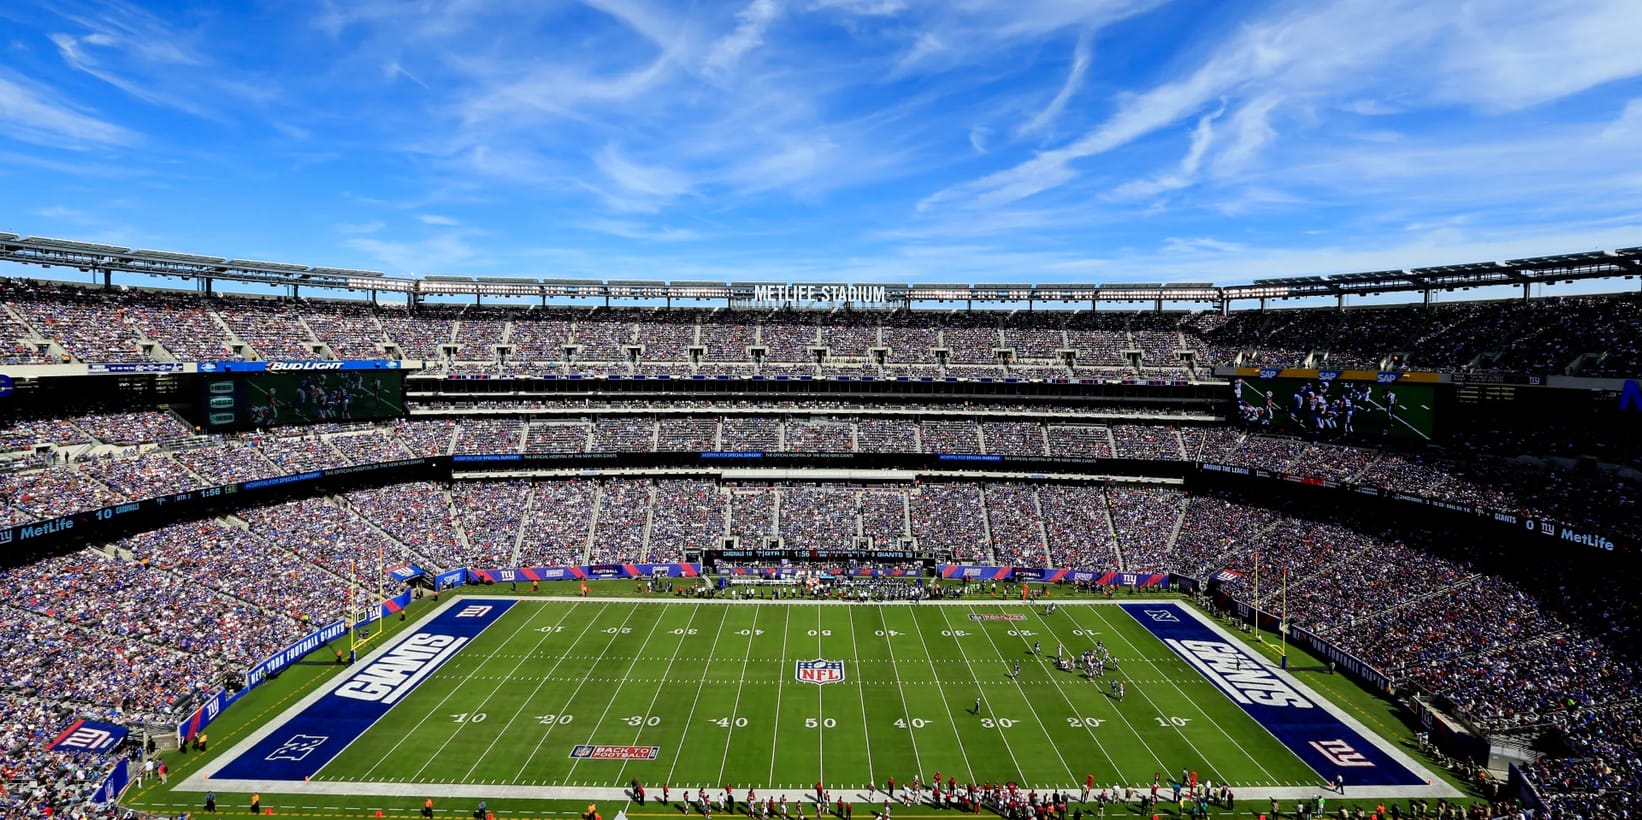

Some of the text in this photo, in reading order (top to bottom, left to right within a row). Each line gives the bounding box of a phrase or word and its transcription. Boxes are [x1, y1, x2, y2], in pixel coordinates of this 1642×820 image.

[754, 285, 885, 302] METLIFE STADIUM
[271, 361, 344, 370] BUD LIGHT
[1378, 375, 1396, 383] SAP
[200, 488, 221, 498] 1:56
[96, 509, 112, 520] 10
[1494, 513, 1534, 530] GIANTS 0
[20, 518, 74, 540] MetLife
[1561, 528, 1614, 551] MetLife
[501, 570, 515, 580] ny
[1123, 574, 1137, 584] ny
[266, 653, 285, 673] YORK
[287, 635, 319, 664] FOOTBALL
[320, 623, 345, 641] GIANTS
[335, 633, 455, 701] GIANTS
[802, 669, 839, 681] NFL
[1180, 640, 1314, 709] GIANTS
[1361, 665, 1385, 691] GIANTS
[207, 699, 219, 720] ny
[453, 713, 487, 723] 10
[539, 714, 574, 725] 20
[627, 716, 661, 727] 30
[716, 717, 748, 727] 40
[805, 718, 836, 728] 50
[893, 718, 925, 728] 40
[981, 718, 1013, 728] 30
[1067, 717, 1100, 728] 20
[1154, 716, 1186, 727] 10
[60, 727, 114, 749] ny
[1308, 739, 1376, 767] ny
